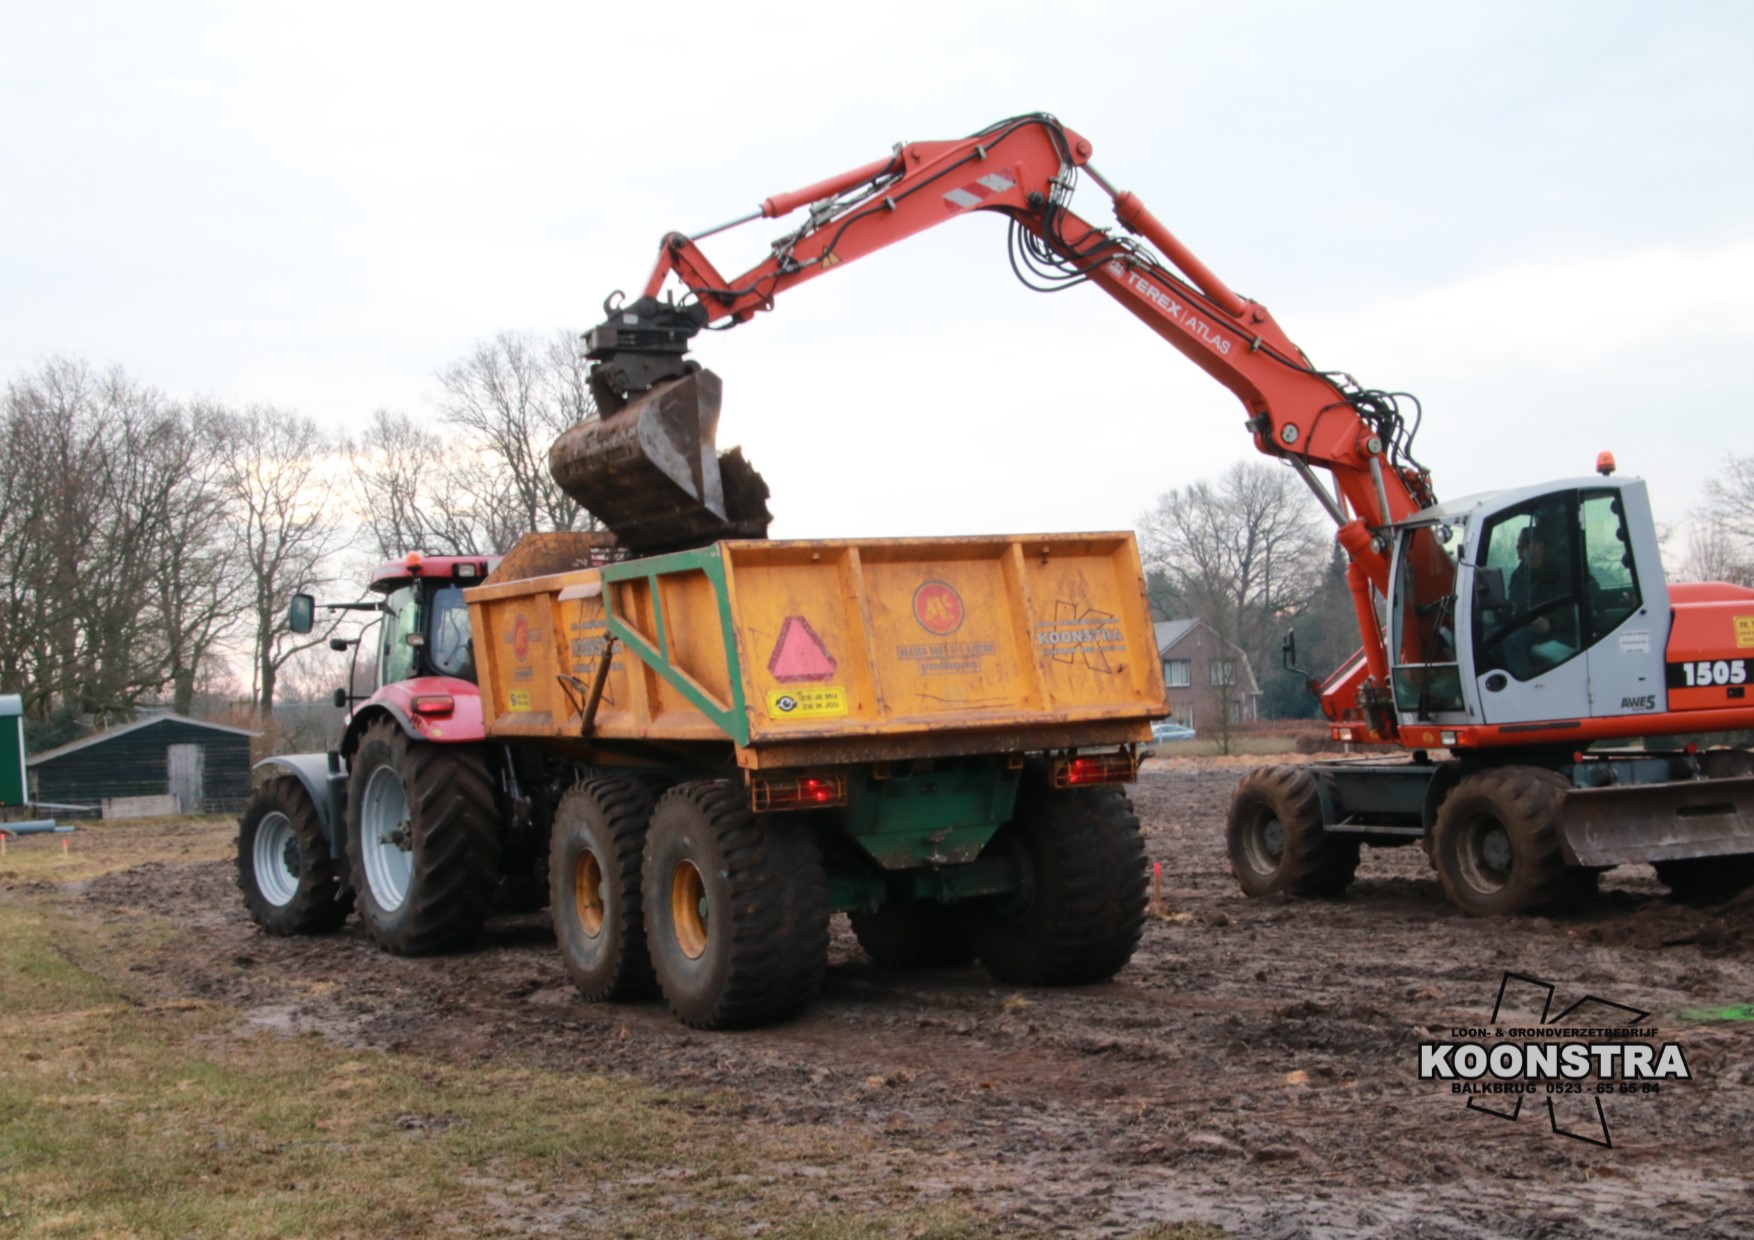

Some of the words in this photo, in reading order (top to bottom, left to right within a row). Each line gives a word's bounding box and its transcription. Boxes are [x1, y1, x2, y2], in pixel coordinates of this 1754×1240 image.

[1127, 271, 1182, 319] TEREX
[1185, 316, 1232, 355] ATLAS
[1038, 628, 1123, 645] KOONSTRA
[1683, 660, 1746, 686] 1505
